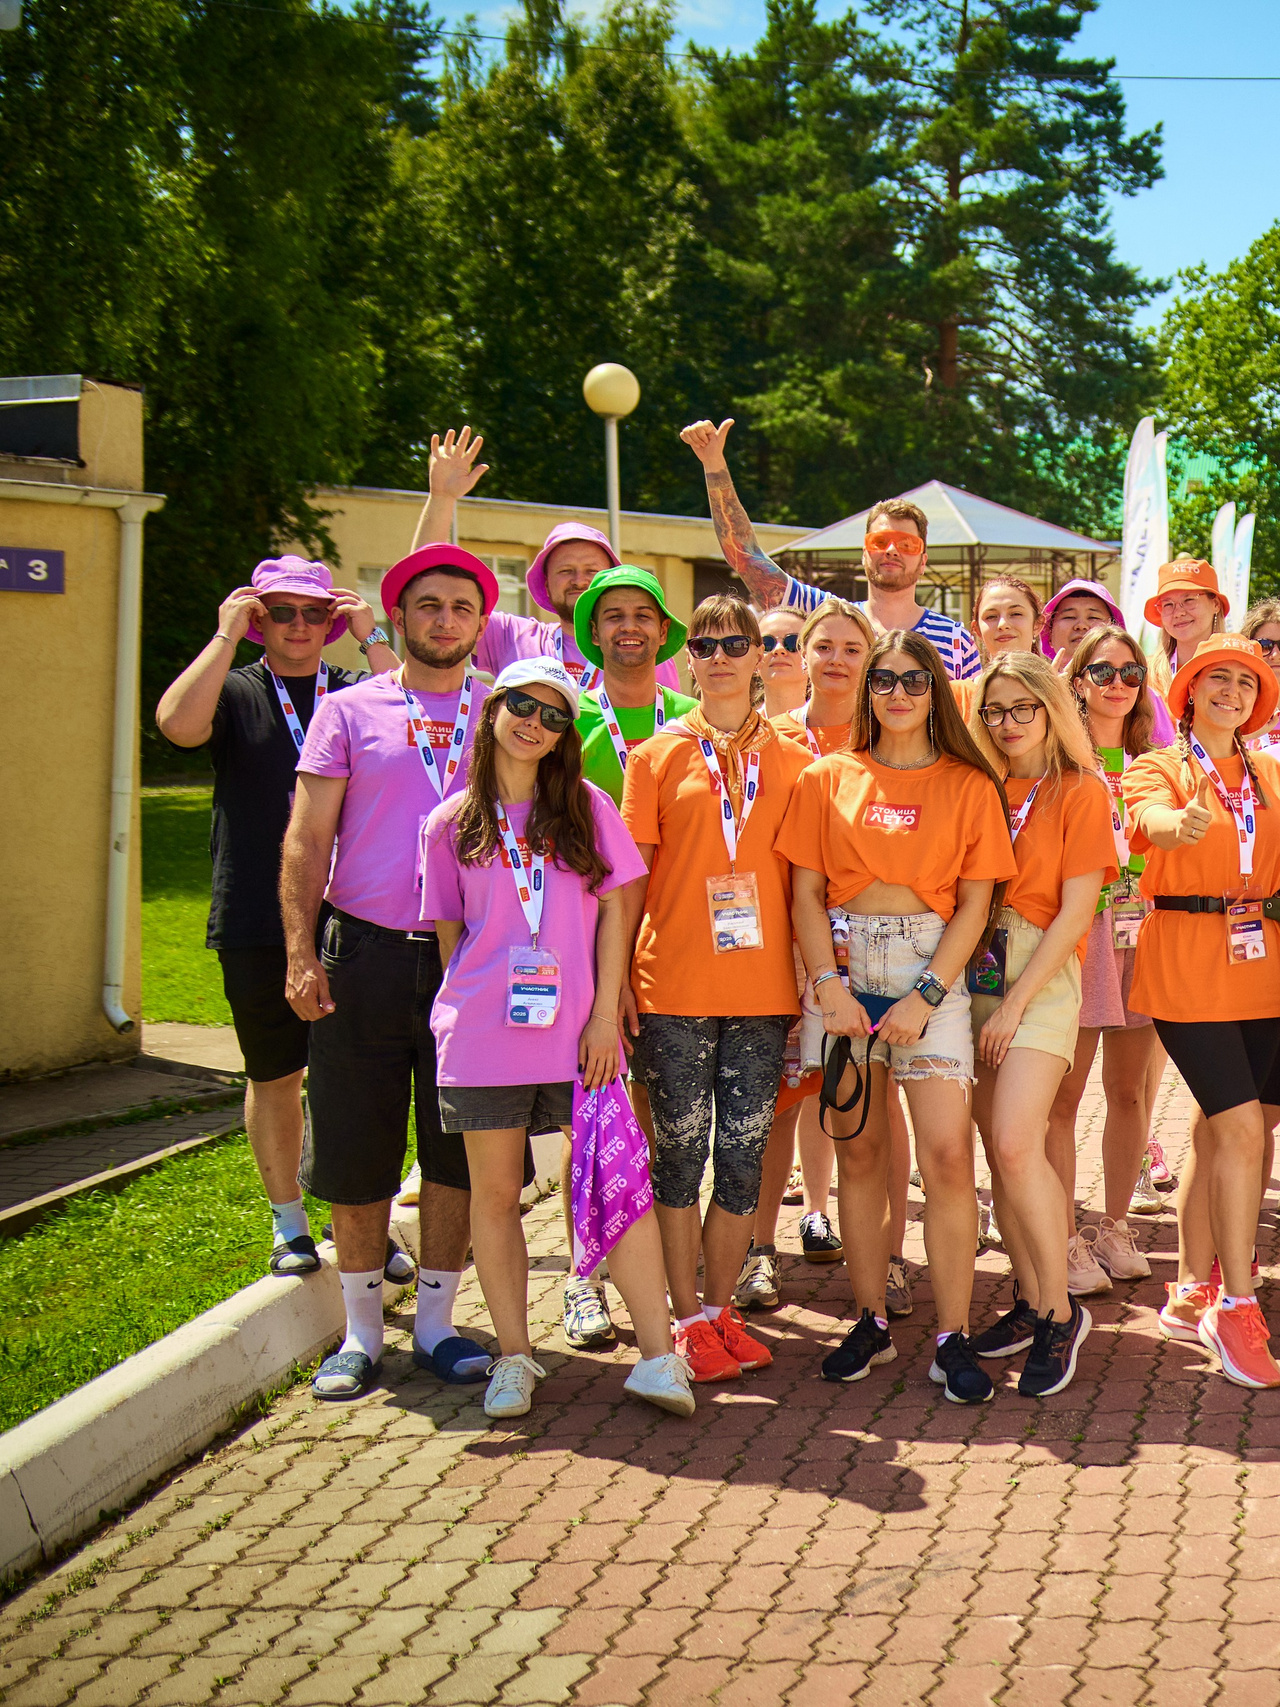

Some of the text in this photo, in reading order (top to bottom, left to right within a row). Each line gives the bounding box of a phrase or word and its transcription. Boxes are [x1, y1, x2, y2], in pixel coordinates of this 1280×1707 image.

[27, 559, 48, 581] 3
[1172, 565, 1200, 574] ЛЕТО
[1222, 641, 1255, 655] ЛЕТО
[870, 812, 916, 826] ЛЕТО
[872, 805, 916, 815] СТОЛИЦА
[582, 1097, 598, 1123] ЛЕТ
[600, 1103, 621, 1131] ЛЕТО
[595, 1135, 621, 1161] СТОЛИЦА
[598, 1140, 626, 1170] ЛЕТО
[601, 1177, 628, 1206] ЛЕТО
[635, 1184, 654, 1211] ЛЕТО
[601, 1209, 624, 1233] СТОЛИЦА
[605, 1212, 629, 1240] ЛЕТО
[579, 1242, 601, 1272] ЛЕТО
